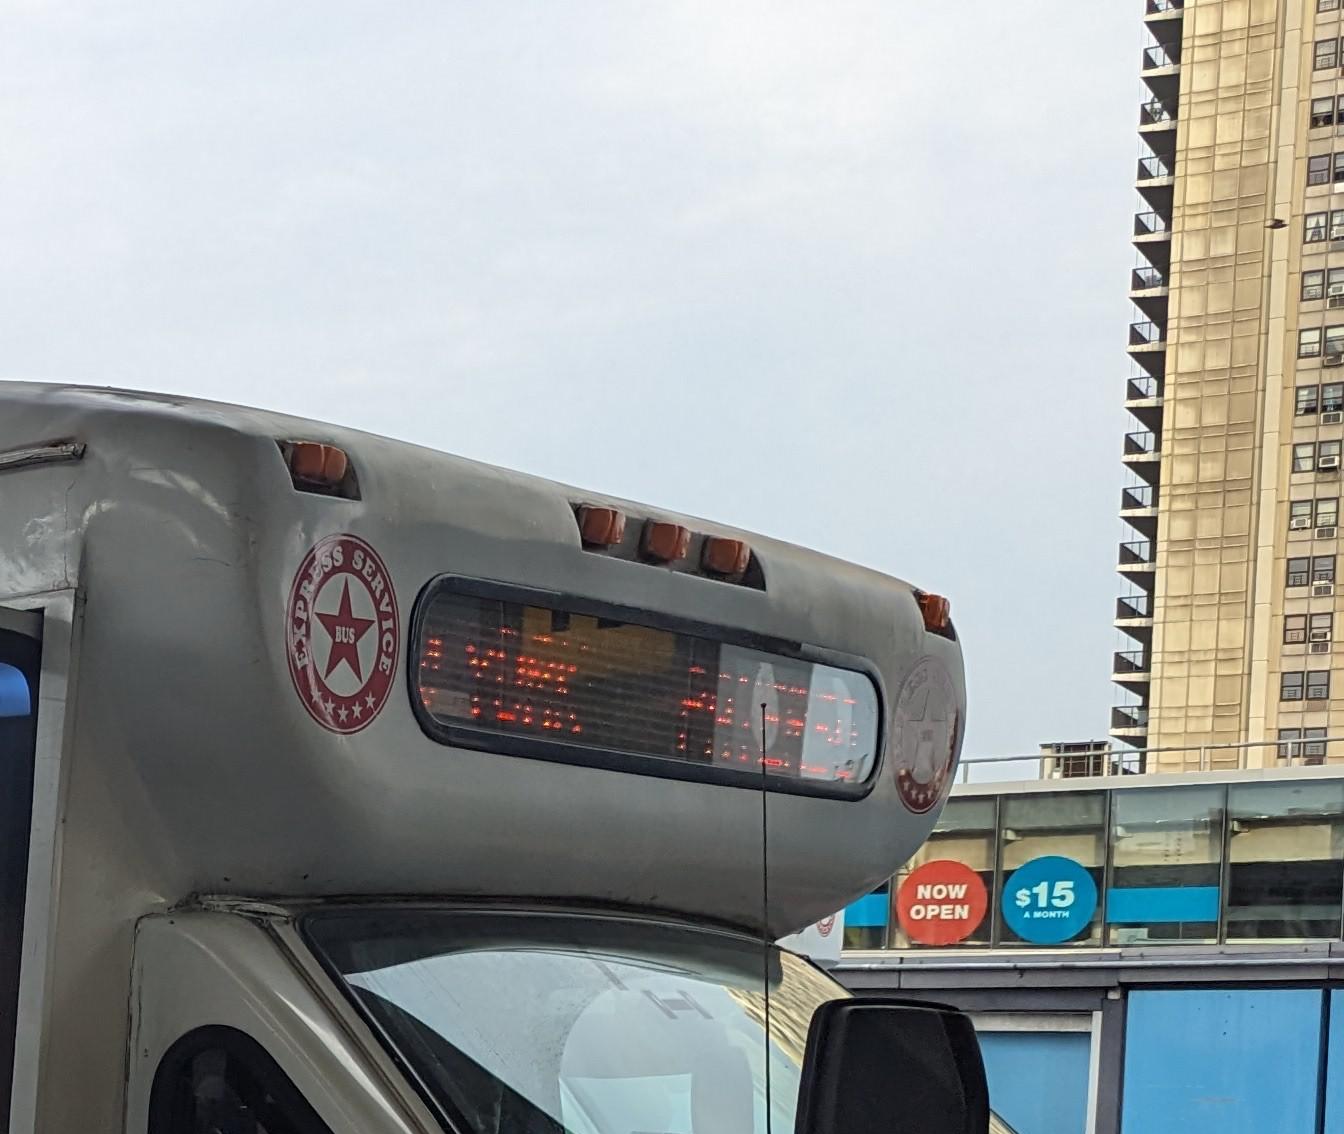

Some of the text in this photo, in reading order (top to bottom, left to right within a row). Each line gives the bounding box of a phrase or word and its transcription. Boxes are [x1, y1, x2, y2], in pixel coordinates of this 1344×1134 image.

[292, 545, 394, 676] EXPRESS SERVICE
[335, 625, 356, 645] BUS
[916, 883, 968, 900] NOW
[1015, 880, 1075, 908] $15
[909, 904, 970, 920] OPEN
[1023, 910, 1070, 919] A MONTH
